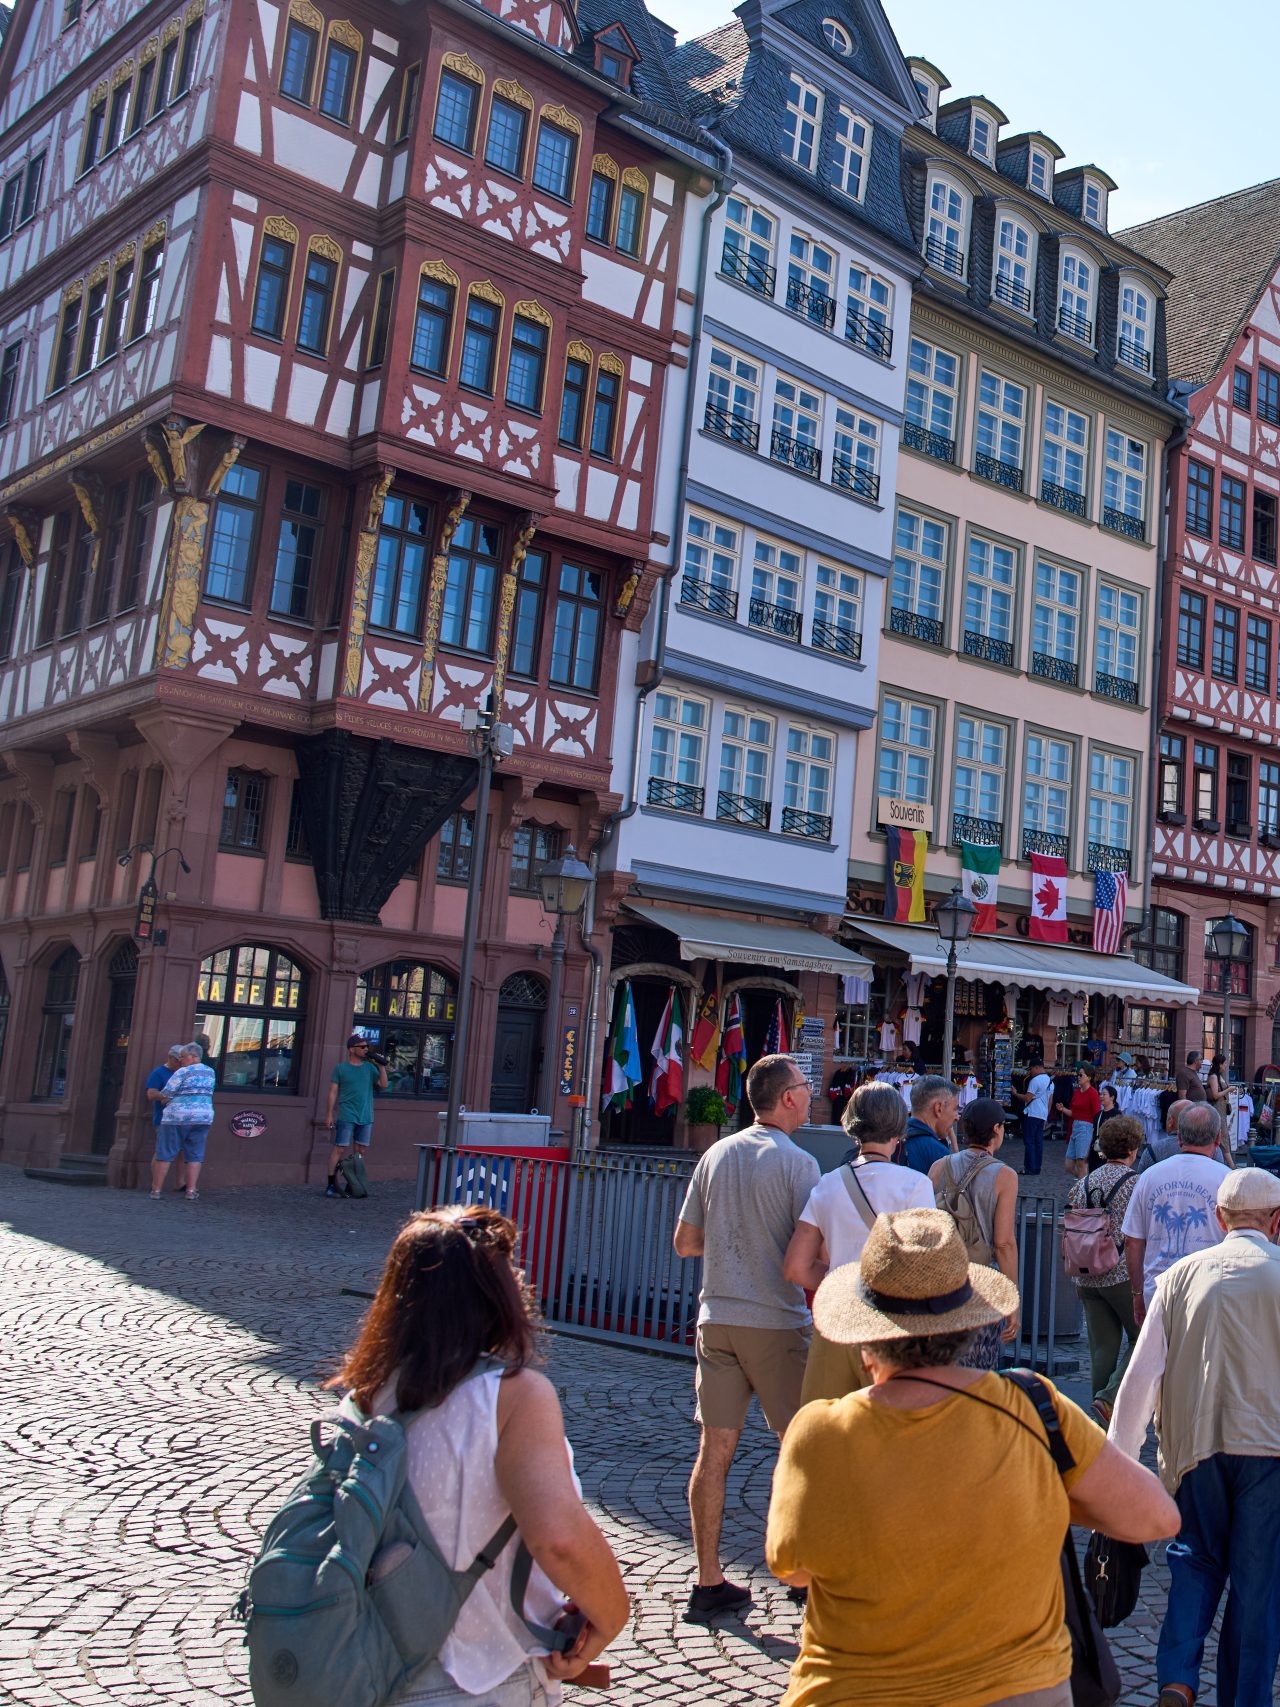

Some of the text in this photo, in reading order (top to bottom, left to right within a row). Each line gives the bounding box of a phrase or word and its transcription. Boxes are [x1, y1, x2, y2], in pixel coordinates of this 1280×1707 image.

[889, 799, 925, 825] Souvenirs
[727, 949, 833, 972] Souvenirs am Samstagsberg
[197, 980, 299, 1008] KAFFEE
[1147, 1181, 1193, 1211] CALIFORNIA
